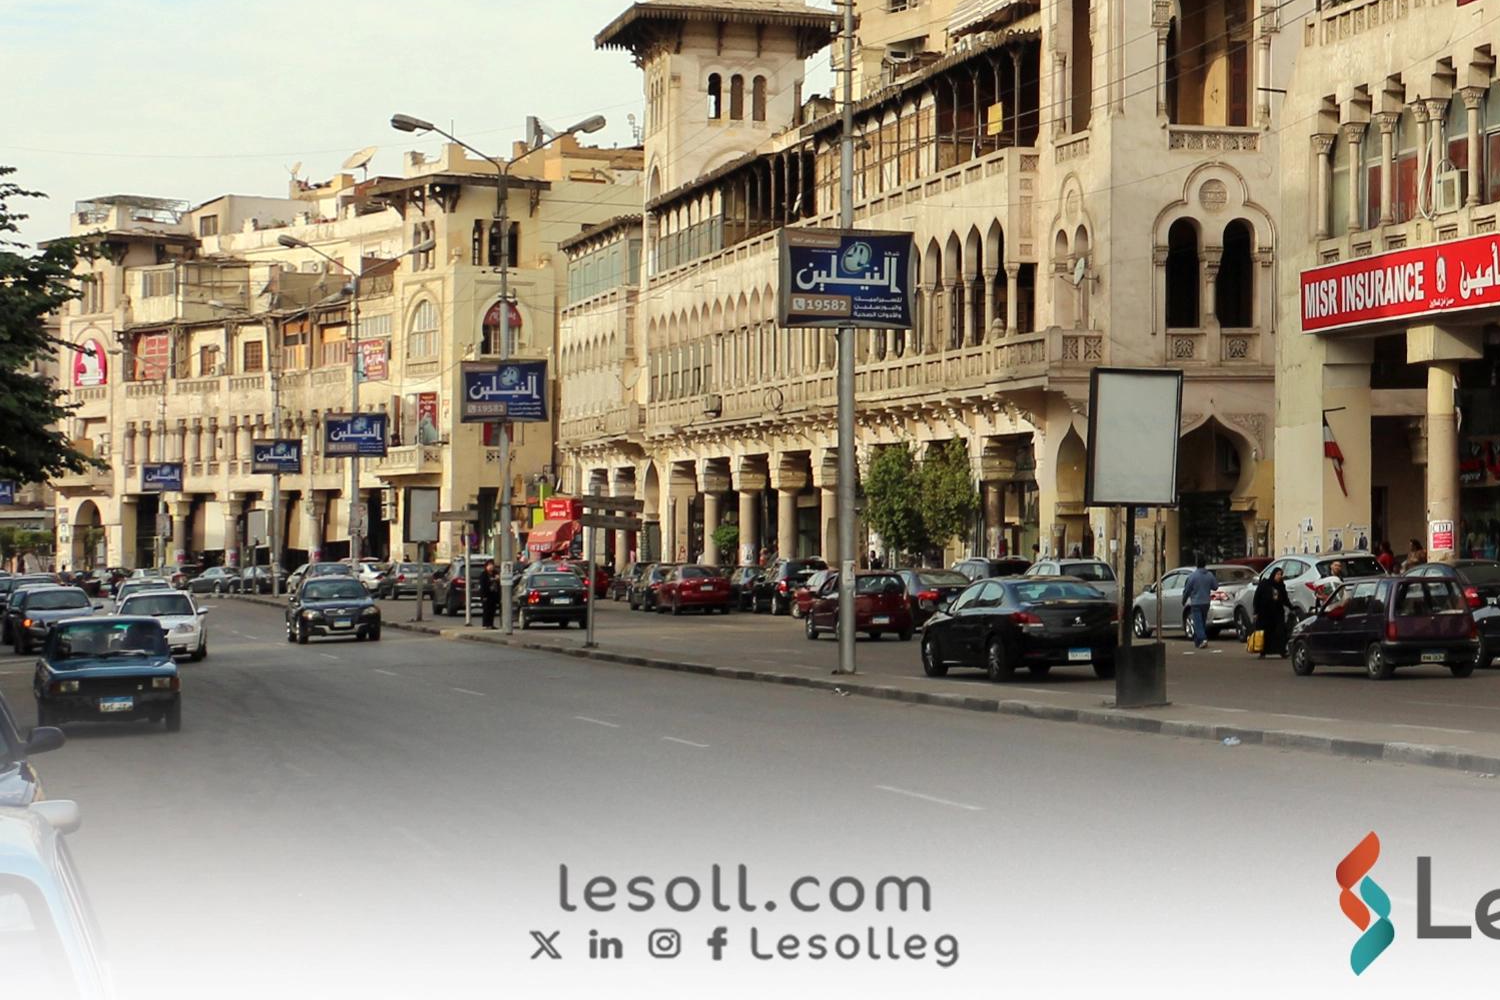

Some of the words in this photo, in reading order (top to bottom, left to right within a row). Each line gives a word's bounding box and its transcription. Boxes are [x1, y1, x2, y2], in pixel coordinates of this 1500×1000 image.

[806, 299, 848, 311] 19582
[1305, 280, 1337, 319] MISR
[1341, 261, 1424, 313] INSURANCE
